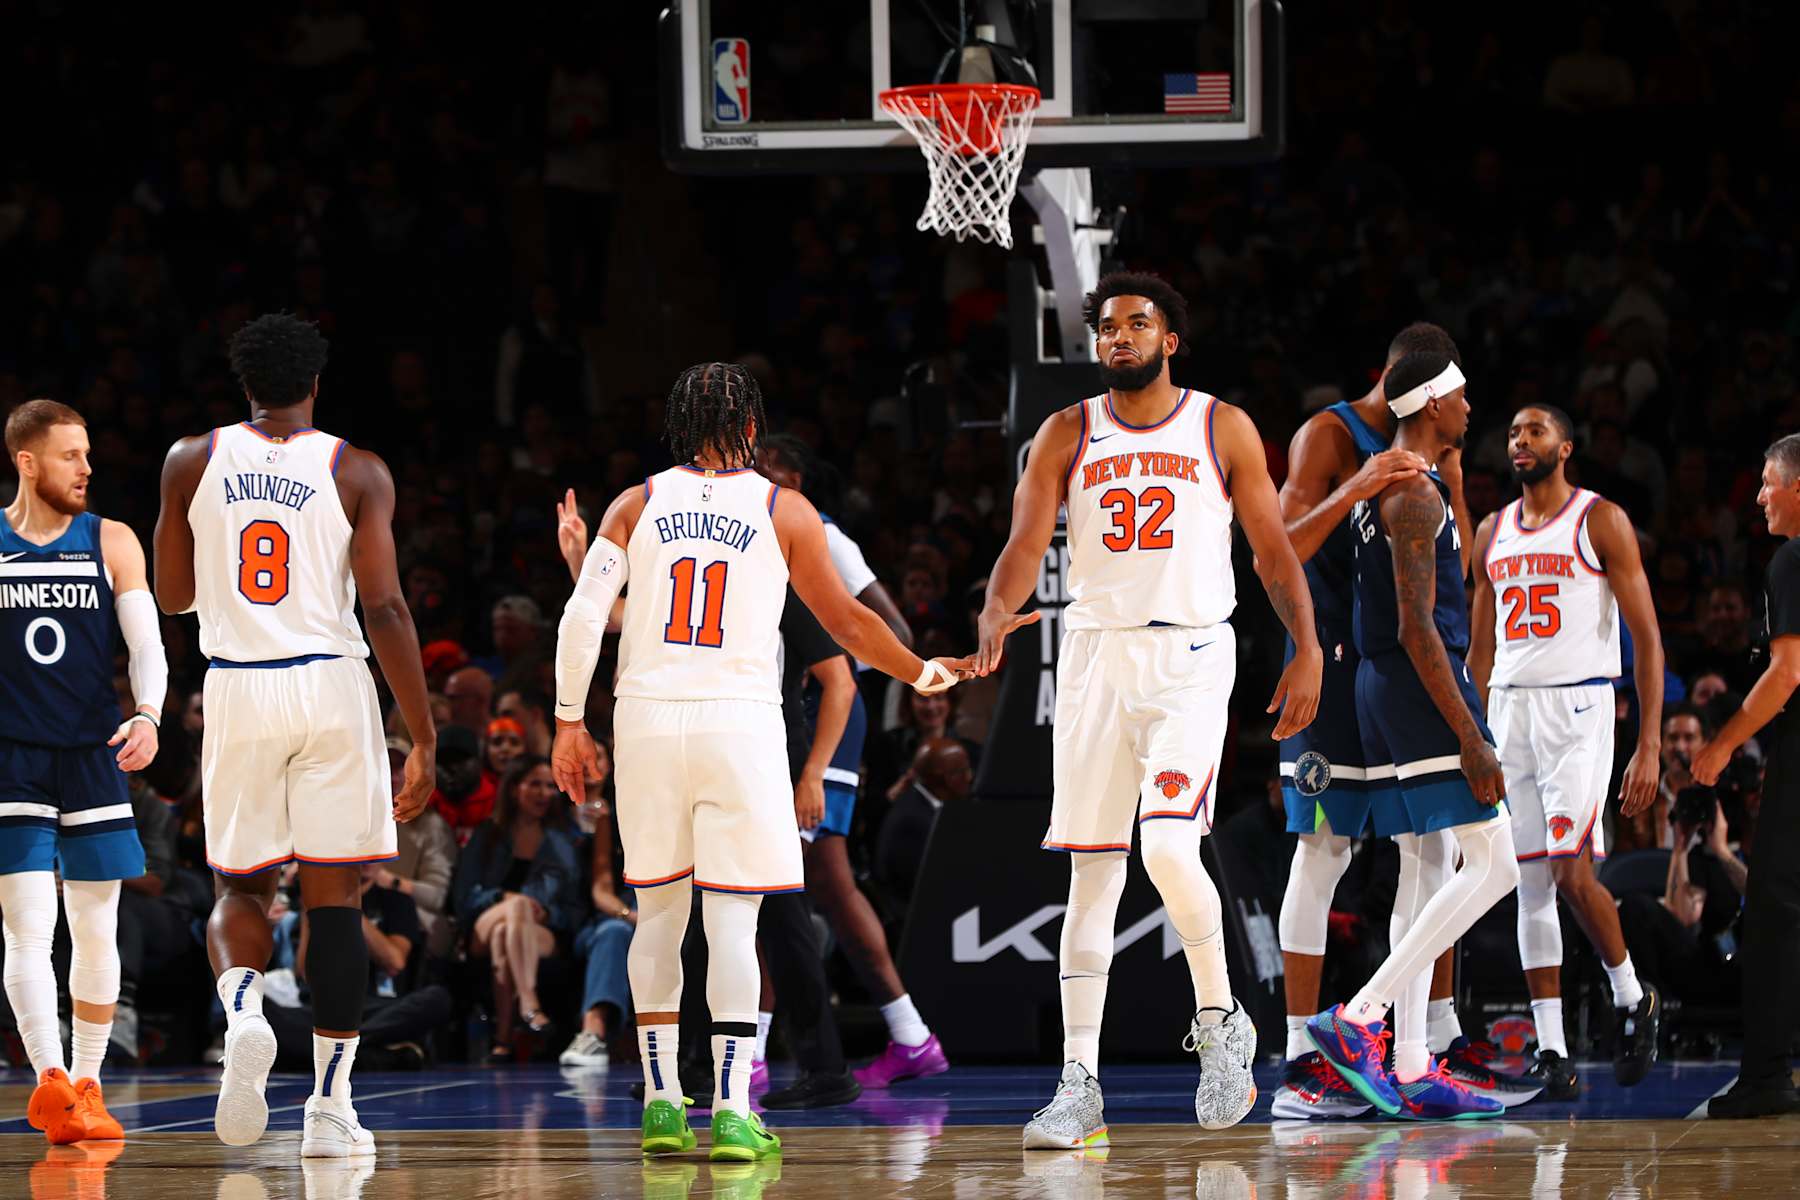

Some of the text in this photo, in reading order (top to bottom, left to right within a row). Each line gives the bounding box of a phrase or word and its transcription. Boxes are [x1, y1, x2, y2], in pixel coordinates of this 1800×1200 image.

[223, 473, 316, 512] ANUNOBY
[1083, 451, 1200, 490] NEW YORK
[655, 512, 757, 553] BRUNSON
[1100, 486, 1175, 552] 32
[238, 519, 290, 606] 8
[1488, 553, 1575, 582] NEW YORK
[0, 583, 100, 609] INNESOTA
[664, 556, 728, 649] 11
[1502, 584, 1561, 641] 25
[24, 616, 66, 665] 0
